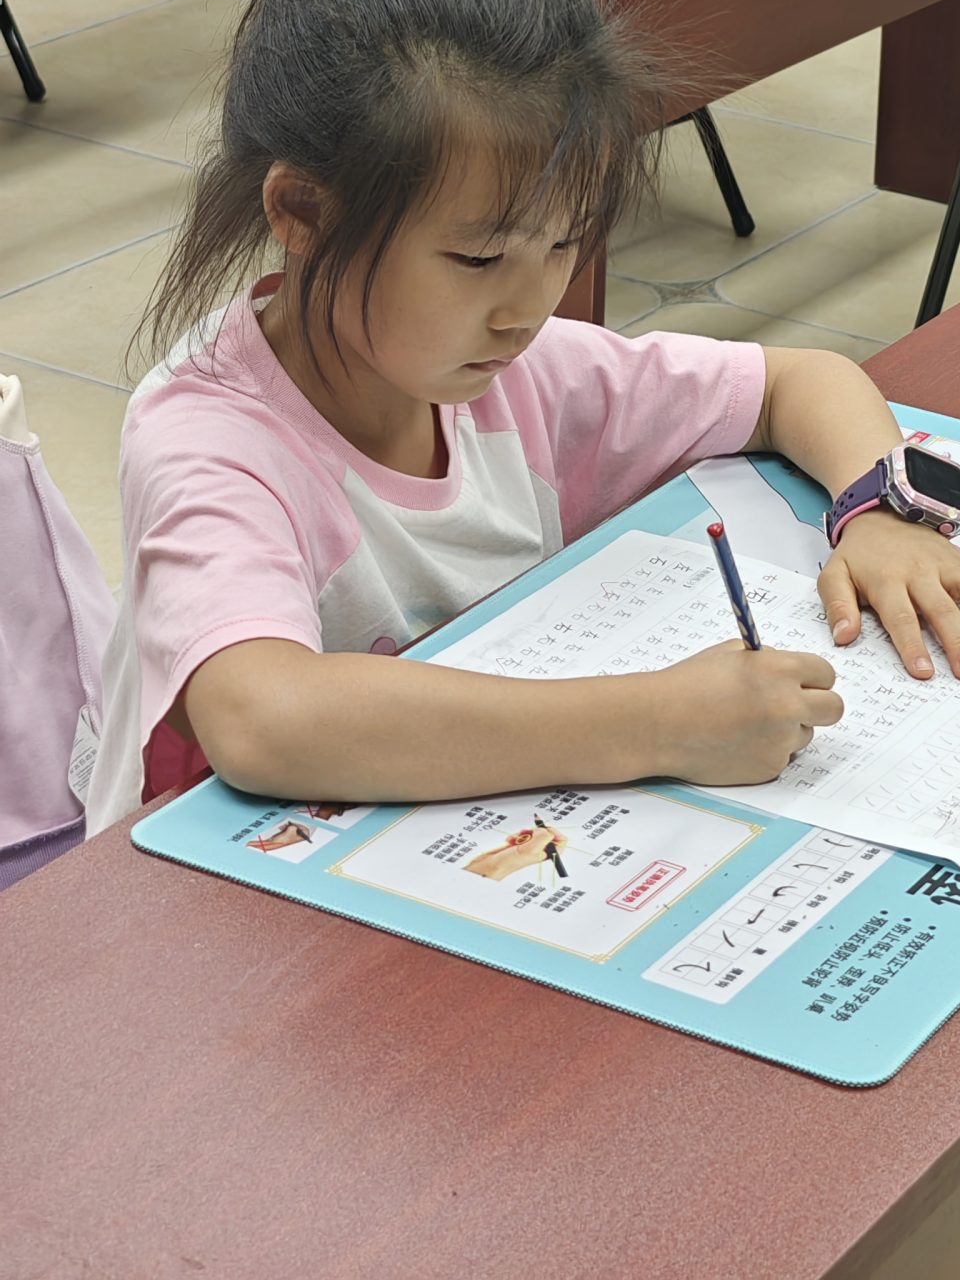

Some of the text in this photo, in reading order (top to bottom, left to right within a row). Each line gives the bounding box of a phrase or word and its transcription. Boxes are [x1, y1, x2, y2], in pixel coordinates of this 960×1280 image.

[798, 913, 888, 989] 预防近视防止驼背
[802, 921, 913, 1016] 防止低头、歪脖、趴桌
[827, 929, 937, 1024] 有效矫正不良写字姿势
